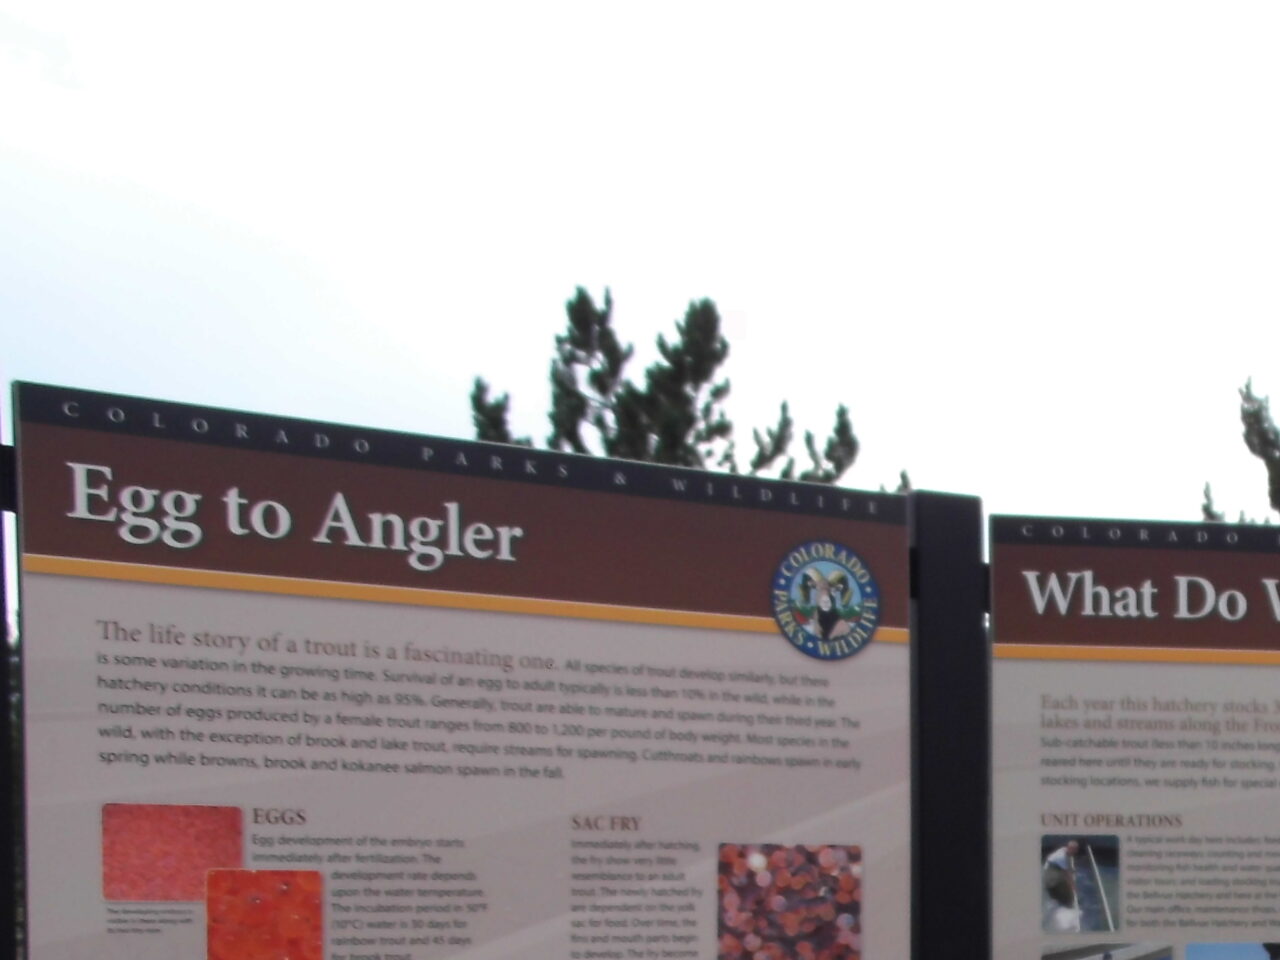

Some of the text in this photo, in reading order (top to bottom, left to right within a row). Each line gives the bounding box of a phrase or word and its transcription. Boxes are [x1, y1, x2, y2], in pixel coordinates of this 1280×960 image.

[62, 401, 369, 454] COLORADO
[422, 447, 567, 477] PARKS
[671, 478, 879, 514] WILDLIFE
[66, 462, 523, 571] Egg to Angler
[1021, 525, 1239, 544] COLORADO
[781, 542, 869, 583] COLORADO
[1023, 570, 1157, 617] What
[1174, 577, 1246, 620] Do
[774, 589, 806, 645] PARKS
[817, 596, 879, 656] WILDLIFE
[98, 621, 142, 644] The
[148, 623, 186, 647] life
[191, 629, 250, 657] story
[256, 631, 280, 653] of
[285, 639, 298, 654] a
[302, 635, 357, 658] trout
[362, 637, 380, 659] is
[385, 646, 398, 660] a
[403, 640, 514, 674] fascinating
[1039, 714, 1080, 729] lakes
[1082, 715, 1113, 730] and
[1115, 716, 1176, 731] streams
[1178, 716, 1221, 737] along
[1224, 717, 1248, 732] the
[1040, 694, 1079, 710] Each
[1082, 699, 1115, 715] year
[1118, 696, 1148, 711] this
[1150, 696, 1217, 718] hatchery
[1222, 698, 1268, 714] stocks
[252, 808, 306, 824] EGGS
[571, 815, 642, 830] SAC FRY
[1040, 814, 1182, 827] UNIT OPERATIONS
